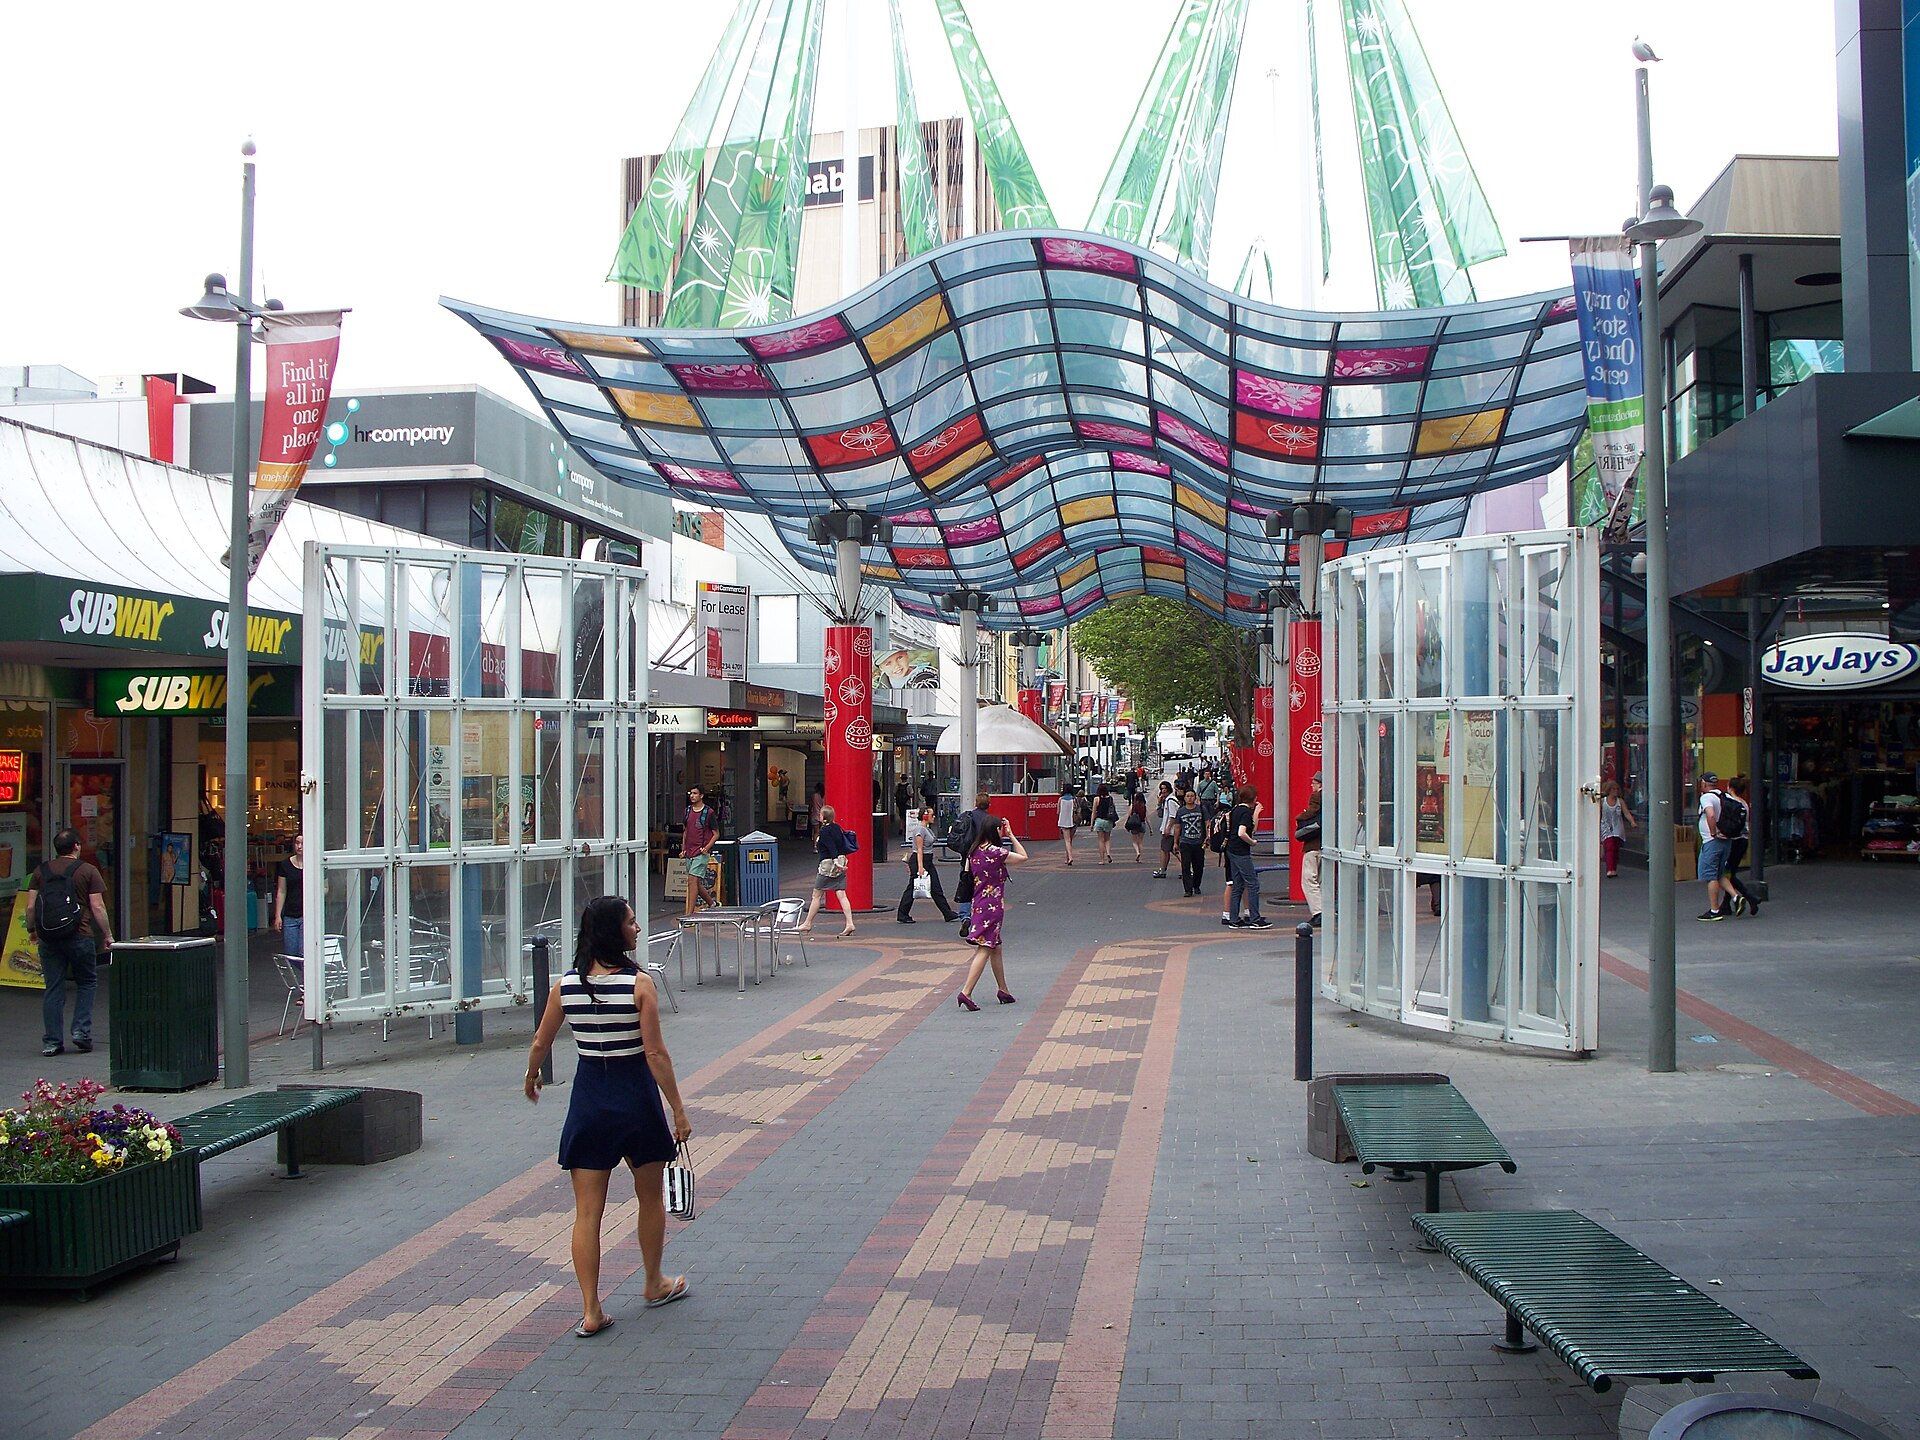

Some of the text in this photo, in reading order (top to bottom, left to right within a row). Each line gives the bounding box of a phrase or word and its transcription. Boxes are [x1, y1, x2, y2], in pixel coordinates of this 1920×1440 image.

[805, 166, 845, 195] ab
[281, 358, 329, 387] Find it
[286, 382, 325, 406] all in
[293, 408, 319, 425] one
[354, 425, 455, 446] hrcompany
[60, 589, 174, 641] SUBWAY
[701, 599, 745, 616] For Lease
[203, 609, 292, 655] SUWAY
[322, 626, 385, 665] SUBAY
[115, 671, 275, 713] SUBWY
[720, 714, 752, 723] Coffees
[1471, 729, 1494, 738] OLLO
[0, 755, 20, 769] AKE
[0, 786, 14, 800] AD
[265, 781, 297, 789] PANDO
[1029, 801, 1058, 809] information
